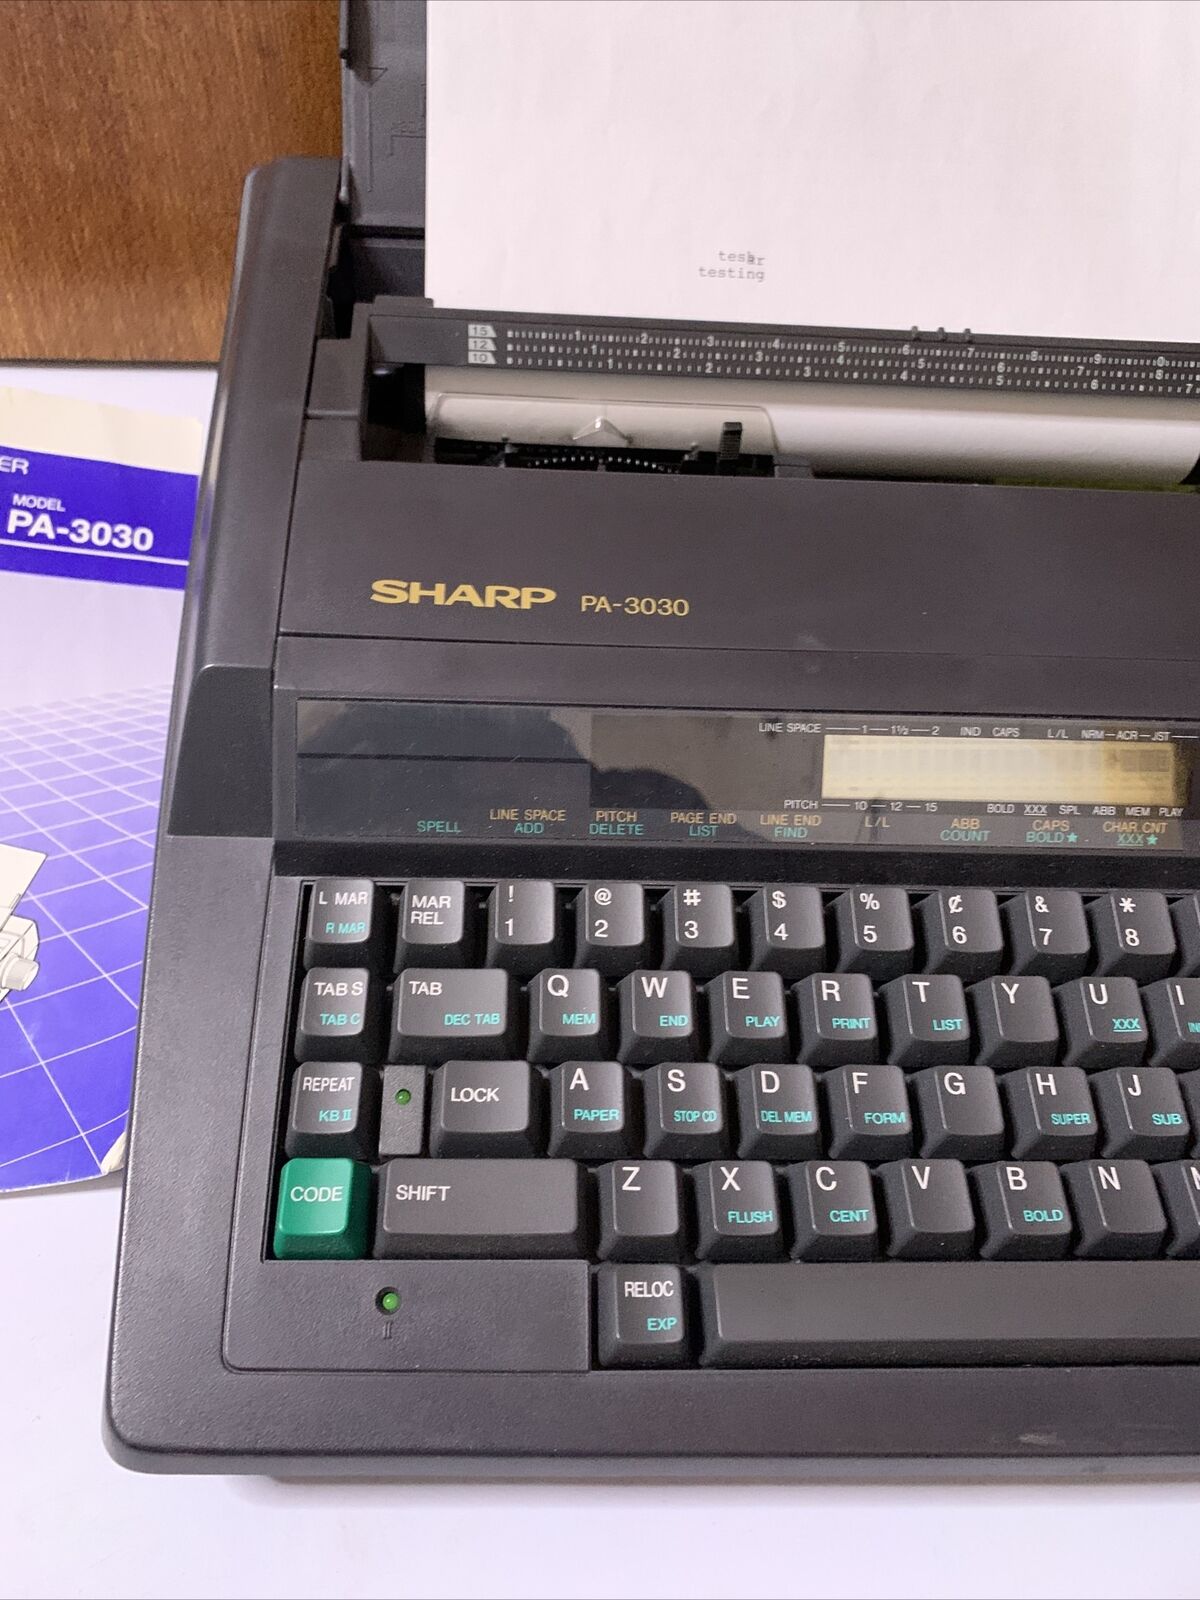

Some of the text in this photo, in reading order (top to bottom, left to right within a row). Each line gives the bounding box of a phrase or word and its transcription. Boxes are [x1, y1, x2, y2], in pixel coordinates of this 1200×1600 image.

[699, 267, 765, 283] testing
[474, 327, 488, 338] 15
[12, 493, 66, 512] MODEL
[7, 509, 155, 551] PA-3030
[370, 579, 690, 616] SHARP PA-3030
[758, 722, 782, 732] LINE
[786, 723, 822, 734] SPACE
[960, 727, 981, 737] IND
[992, 728, 1020, 738] CAPS
[1047, 728, 1068, 739] L/L
[784, 799, 938, 813] PITCH 10 12 15
[987, 803, 1015, 814] BOLD
[1024, 804, 1048, 816] XXX
[1059, 805, 1081, 816] SPL
[1092, 806, 1117, 816] ABB
[489, 808, 567, 822] LINE SPACE
[595, 810, 638, 822] PITCH
[670, 811, 737, 825] PAGE END
[760, 814, 823, 827] LINE END
[864, 816, 890, 828] L/L
[416, 820, 462, 833] SPELL
[514, 822, 545, 834] ADD
[589, 823, 644, 836] DELETE
[689, 825, 719, 837] LIST
[951, 818, 980, 830] ABB
[1032, 819, 1071, 832] CAPS
[1102, 821, 1168, 834] CHAR CNT
[774, 827, 809, 839] FIND
[940, 829, 991, 842] COUNT
[1025, 831, 1065, 844] BOLD
[1117, 833, 1145, 847] XXX
[319, 891, 368, 906] L MAR
[508, 885, 514, 903] !
[594, 887, 612, 906] @
[683, 889, 701, 906] #
[771, 890, 787, 909] $
[859, 893, 880, 910] %
[411, 895, 452, 909] MAR
[1035, 896, 1049, 913] &
[410, 911, 444, 926] REL
[325, 922, 366, 934] R MAR
[504, 918, 515, 937] 1
[594, 919, 609, 938] 2
[684, 920, 699, 939] 3
[773, 923, 789, 941] 4
[863, 925, 878, 943] 5
[952, 926, 968, 945] 6
[1039, 928, 1053, 946] 7
[1125, 929, 1140, 947] 8
[314, 981, 364, 996] TAB S
[408, 981, 443, 996] TAB
[547, 974, 570, 998] Q
[641, 977, 669, 999] W
[732, 978, 750, 999] E
[821, 980, 841, 1002] R
[912, 981, 930, 1003] T
[1001, 983, 1020, 1004] Y
[1088, 983, 1108, 1005] U
[1175, 984, 1185, 1006] I
[320, 1013, 361, 1026] TAB C
[444, 1012, 501, 1026] DEC TAB
[562, 1013, 596, 1025] MEM
[659, 1015, 689, 1027] END
[745, 1016, 781, 1028] PLAY
[832, 1017, 871, 1029] PRINT
[933, 1018, 964, 1031] LIST
[1112, 1018, 1142, 1032] XXX
[302, 1077, 355, 1092] REPEAT
[569, 1067, 590, 1091] A
[667, 1069, 687, 1092] S
[760, 1070, 781, 1093] D
[852, 1071, 868, 1094] F
[944, 1072, 966, 1096] G
[1035, 1073, 1057, 1096] H
[1127, 1074, 1142, 1096] J
[451, 1087, 500, 1103] LOCK
[318, 1109, 340, 1122] KB
[573, 1108, 620, 1122] PAPER
[673, 1110, 700, 1122] STOP
[761, 1110, 812, 1123] DEL MEM
[864, 1111, 907, 1125] FORM
[1051, 1113, 1090, 1125] SUPER
[1152, 1113, 1182, 1126] SUB
[621, 1166, 641, 1191] Z
[720, 1166, 741, 1191] X
[815, 1166, 837, 1191] C
[911, 1166, 931, 1190] V
[1006, 1166, 1028, 1191] B
[1098, 1166, 1121, 1191] N
[290, 1185, 343, 1203] CODE
[396, 1184, 451, 1202] SHIFT
[728, 1210, 773, 1224] FLUSH
[829, 1209, 870, 1223] CENT
[1023, 1209, 1064, 1223] BOLD
[624, 1281, 674, 1298] RELOC
[647, 1317, 678, 1332] EXP
